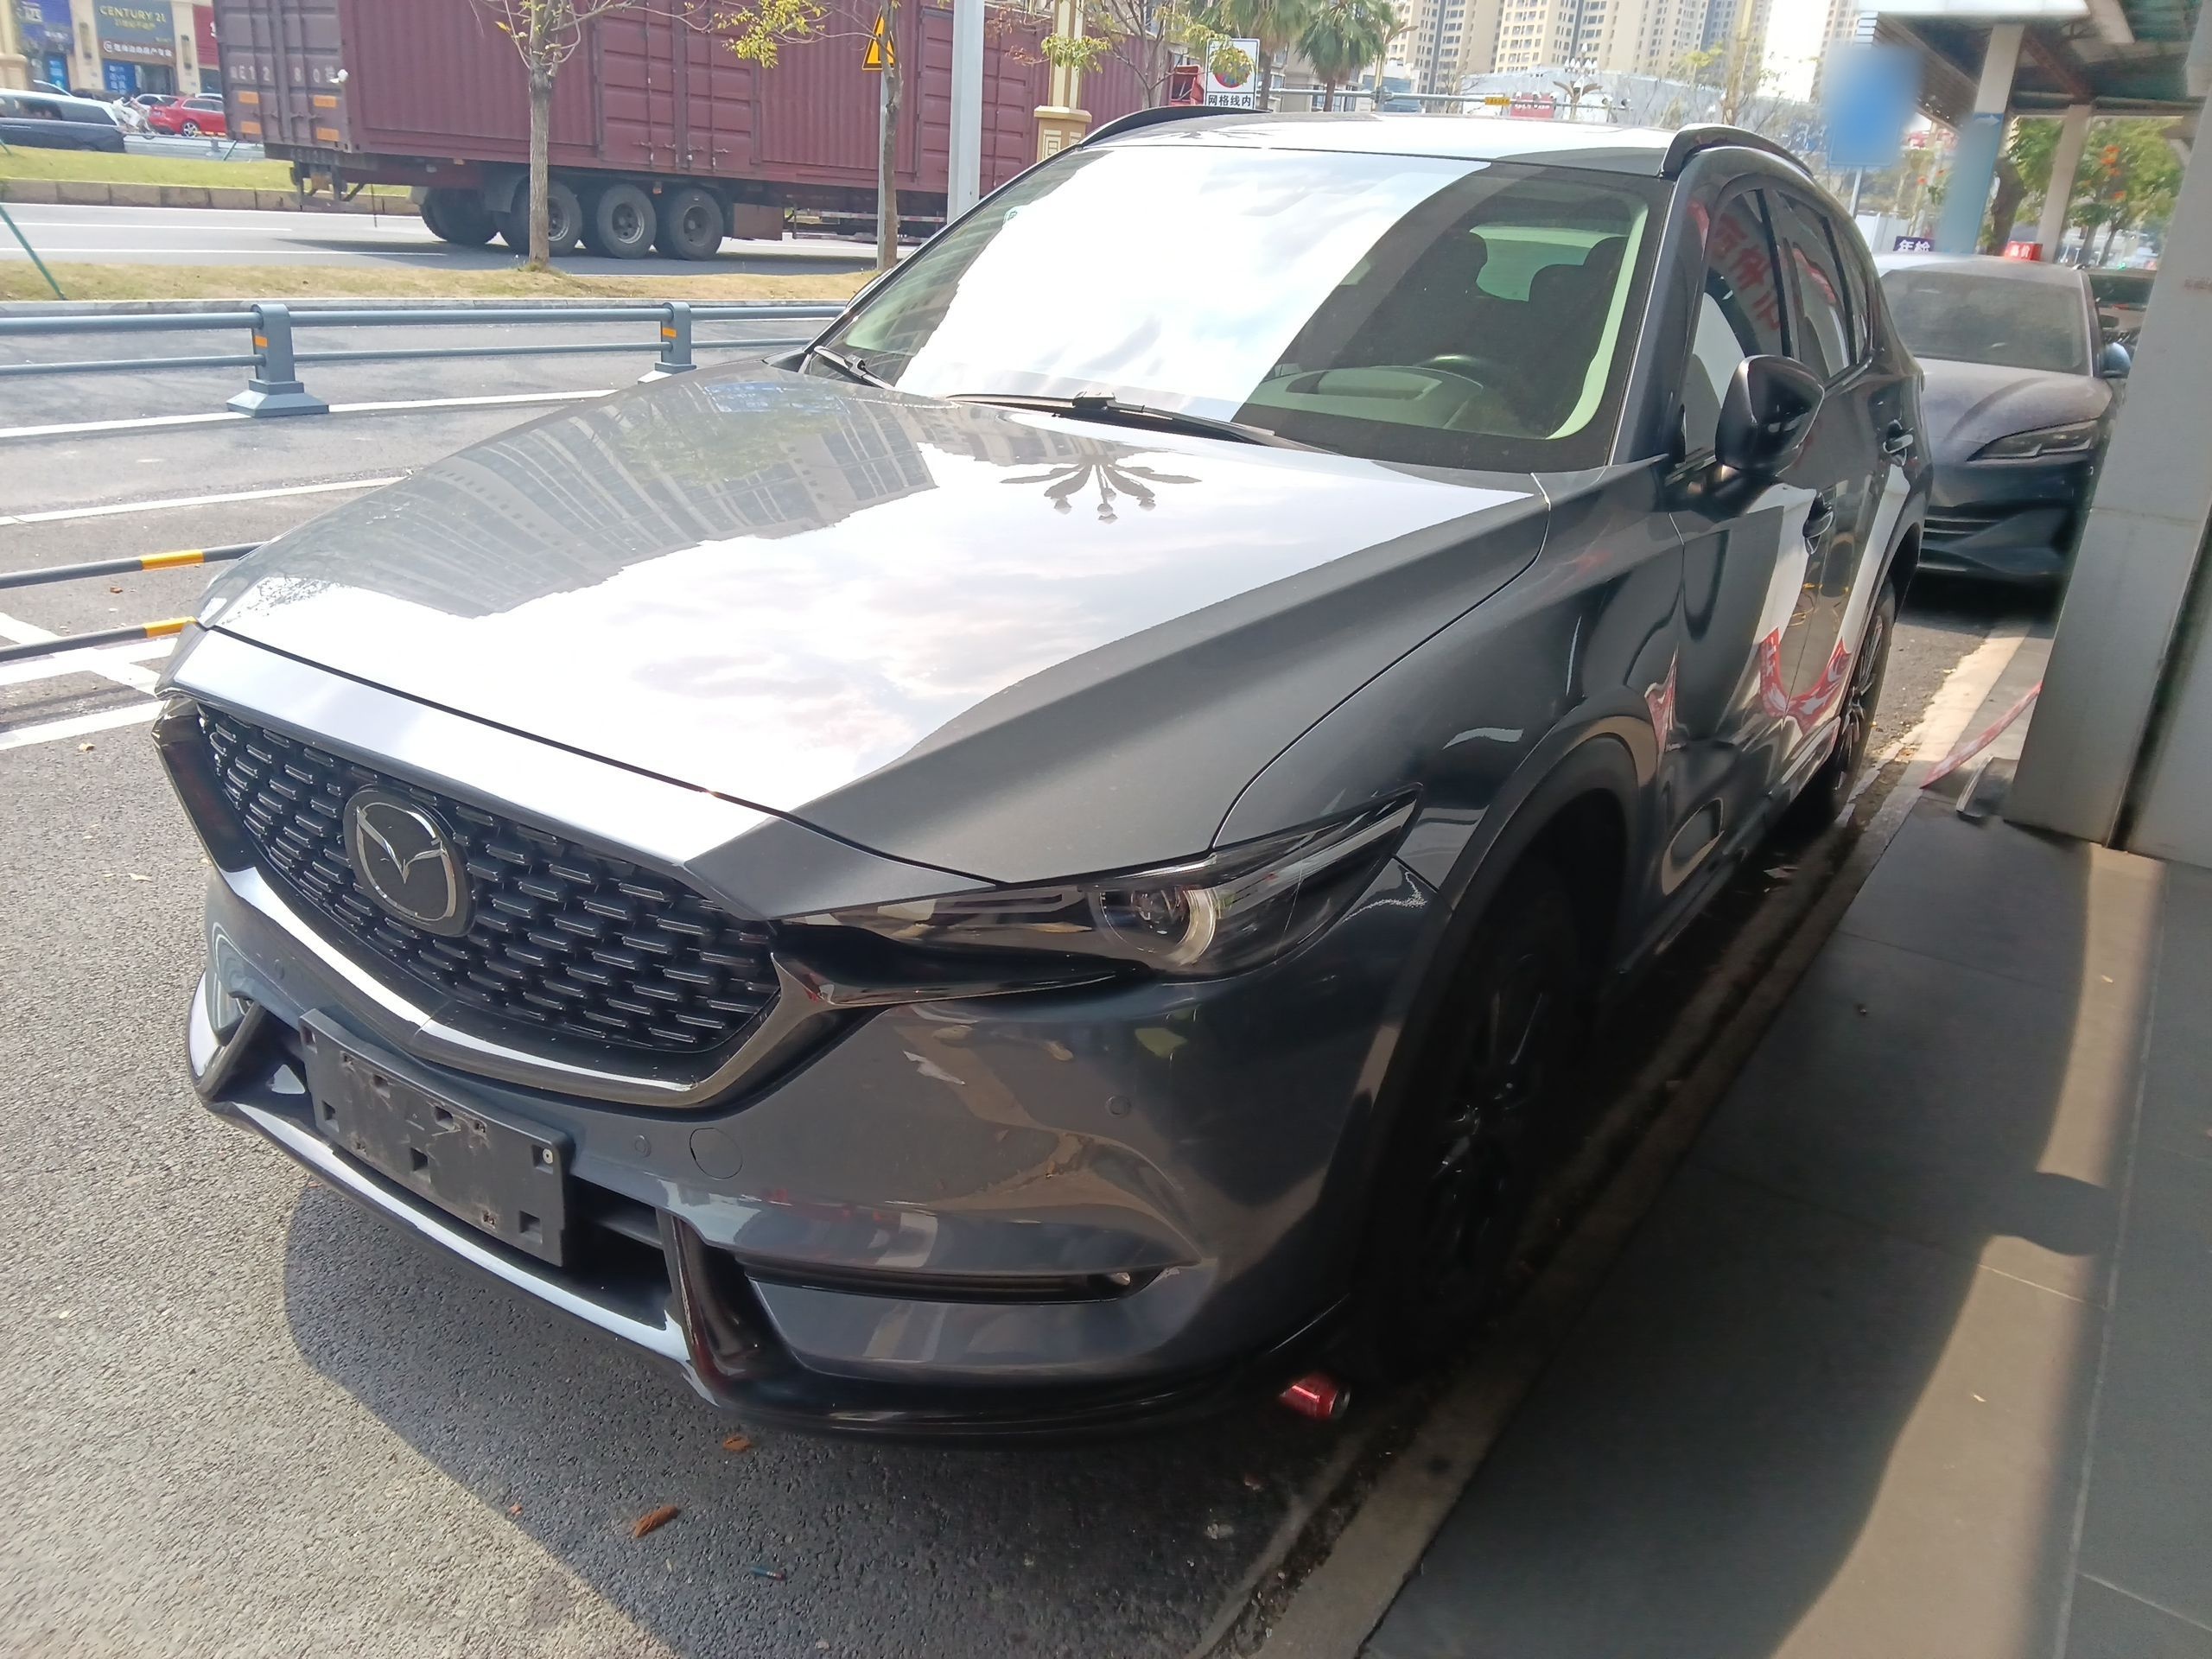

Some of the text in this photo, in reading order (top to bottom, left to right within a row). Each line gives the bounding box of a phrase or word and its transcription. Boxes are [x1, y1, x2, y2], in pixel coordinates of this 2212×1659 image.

[99, 5, 151, 21] CENTURY
[1208, 94, 1251, 106] 网格线内
